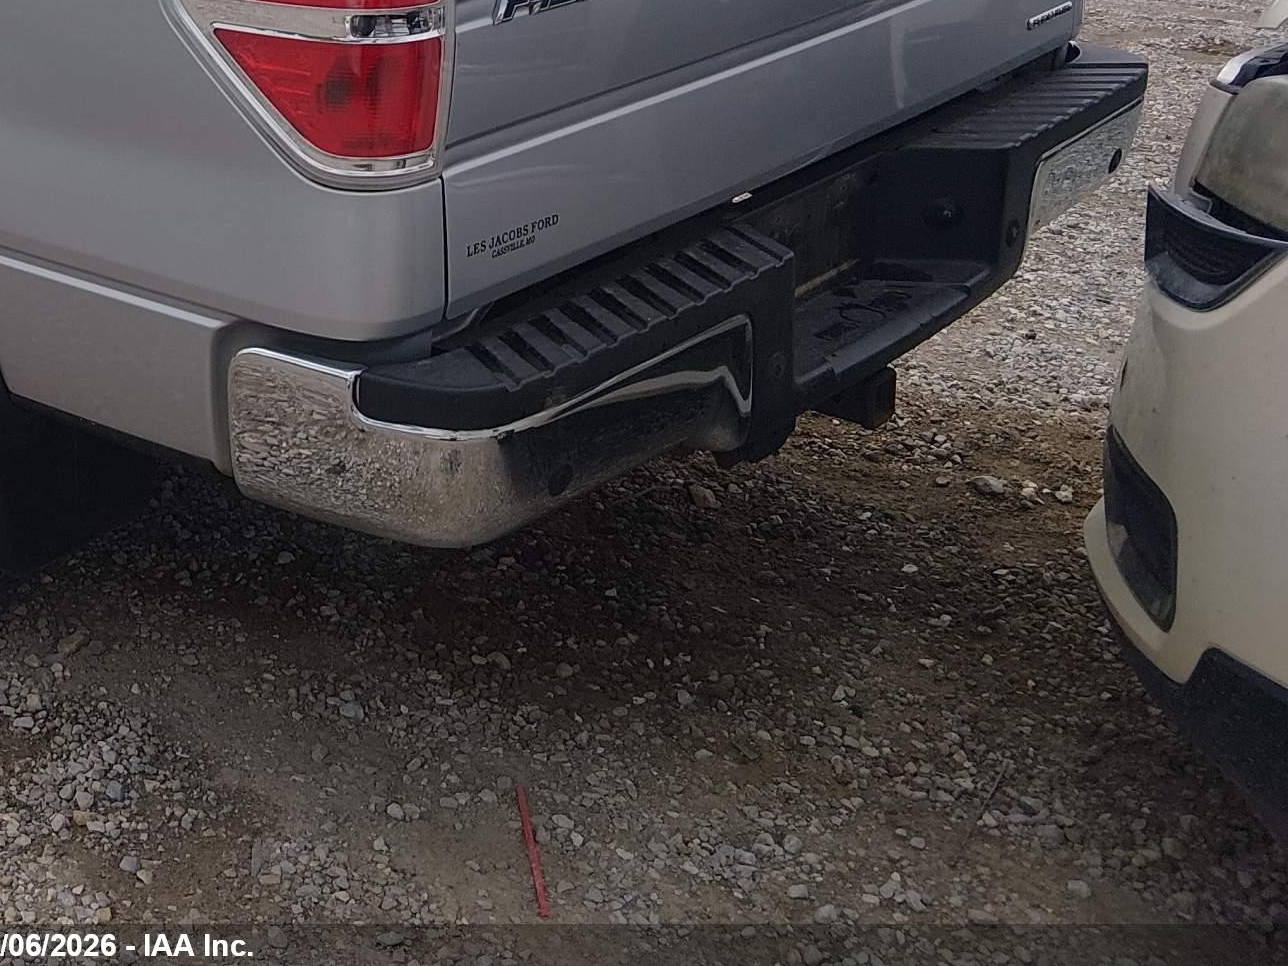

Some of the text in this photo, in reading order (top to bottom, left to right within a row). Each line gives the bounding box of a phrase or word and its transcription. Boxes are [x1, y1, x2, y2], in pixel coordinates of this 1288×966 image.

[465, 214, 560, 258] LES JACOBS FORD
[525, 235, 536, 246] MO
